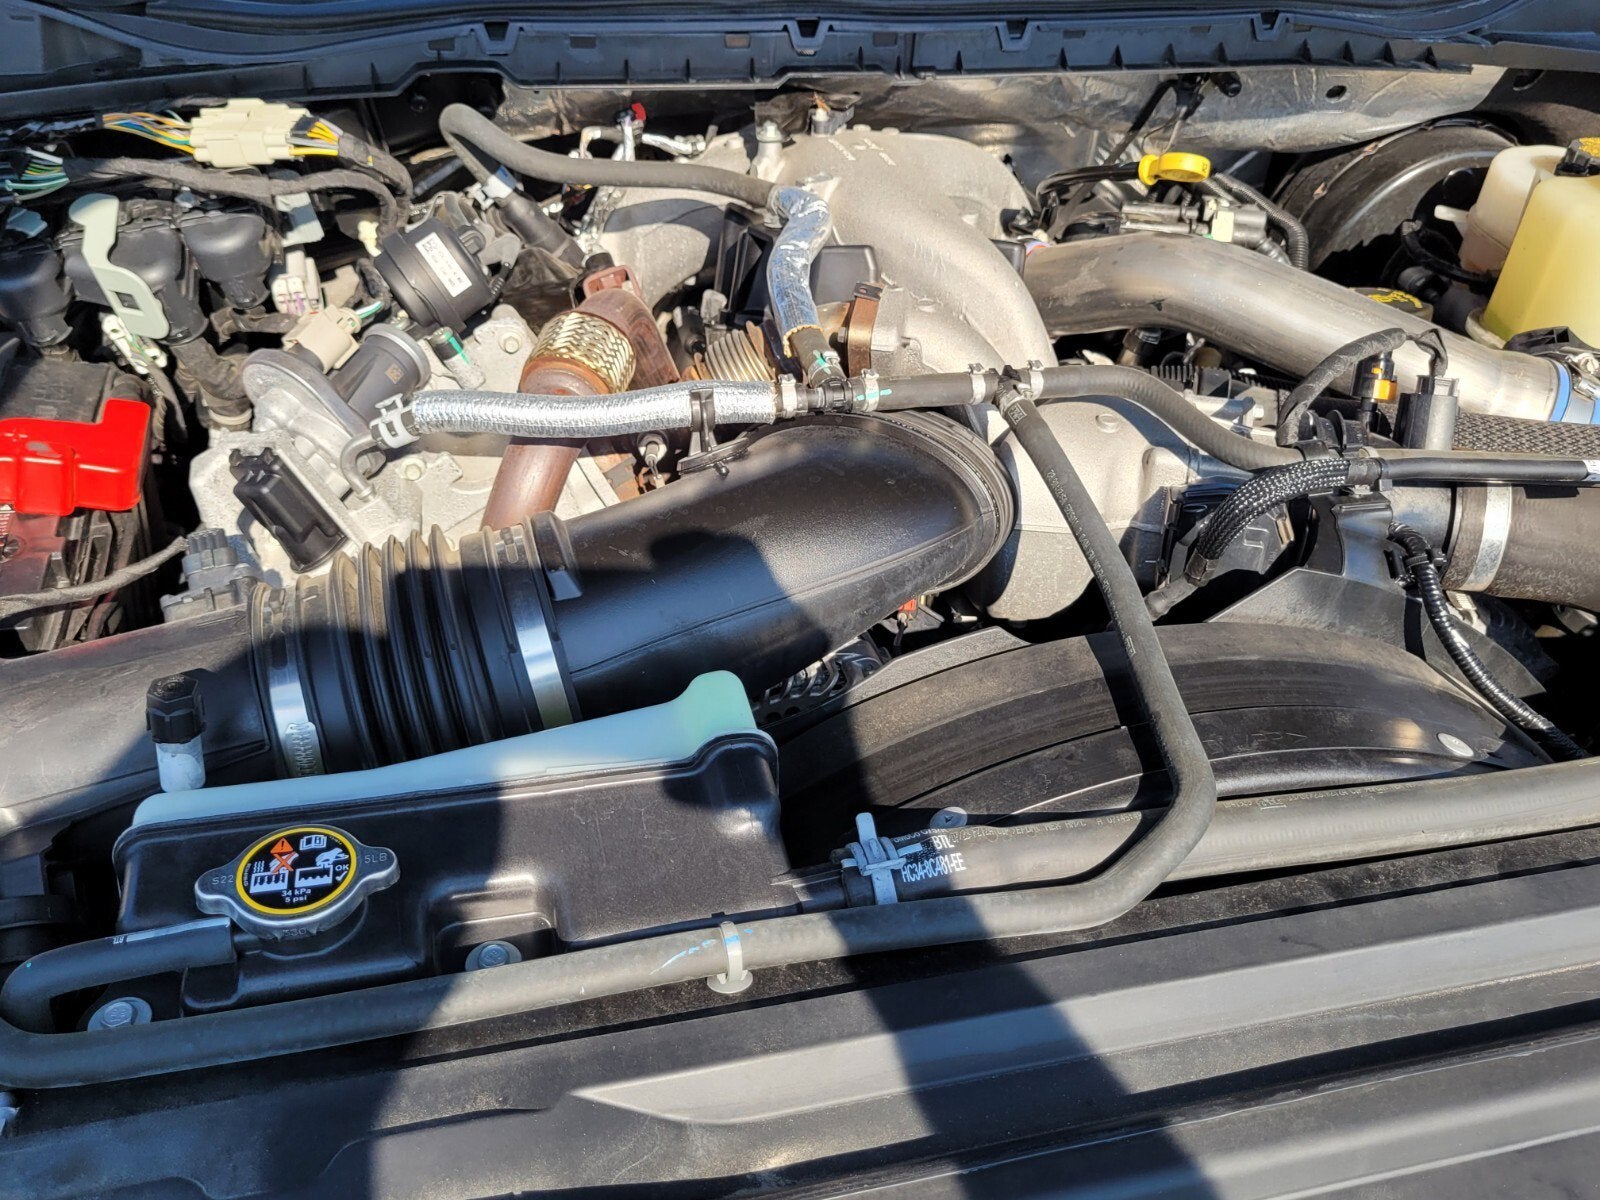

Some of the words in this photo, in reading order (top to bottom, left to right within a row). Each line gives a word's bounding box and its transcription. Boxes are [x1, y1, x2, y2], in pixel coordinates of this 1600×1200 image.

[931, 834, 956, 850] BTL
[335, 863, 349, 872] OK
[901, 852, 967, 883] HC34-8C481-EE
[281, 888, 293, 897] 34
[294, 887, 311, 896] kPa
[292, 895, 308, 903] psi
